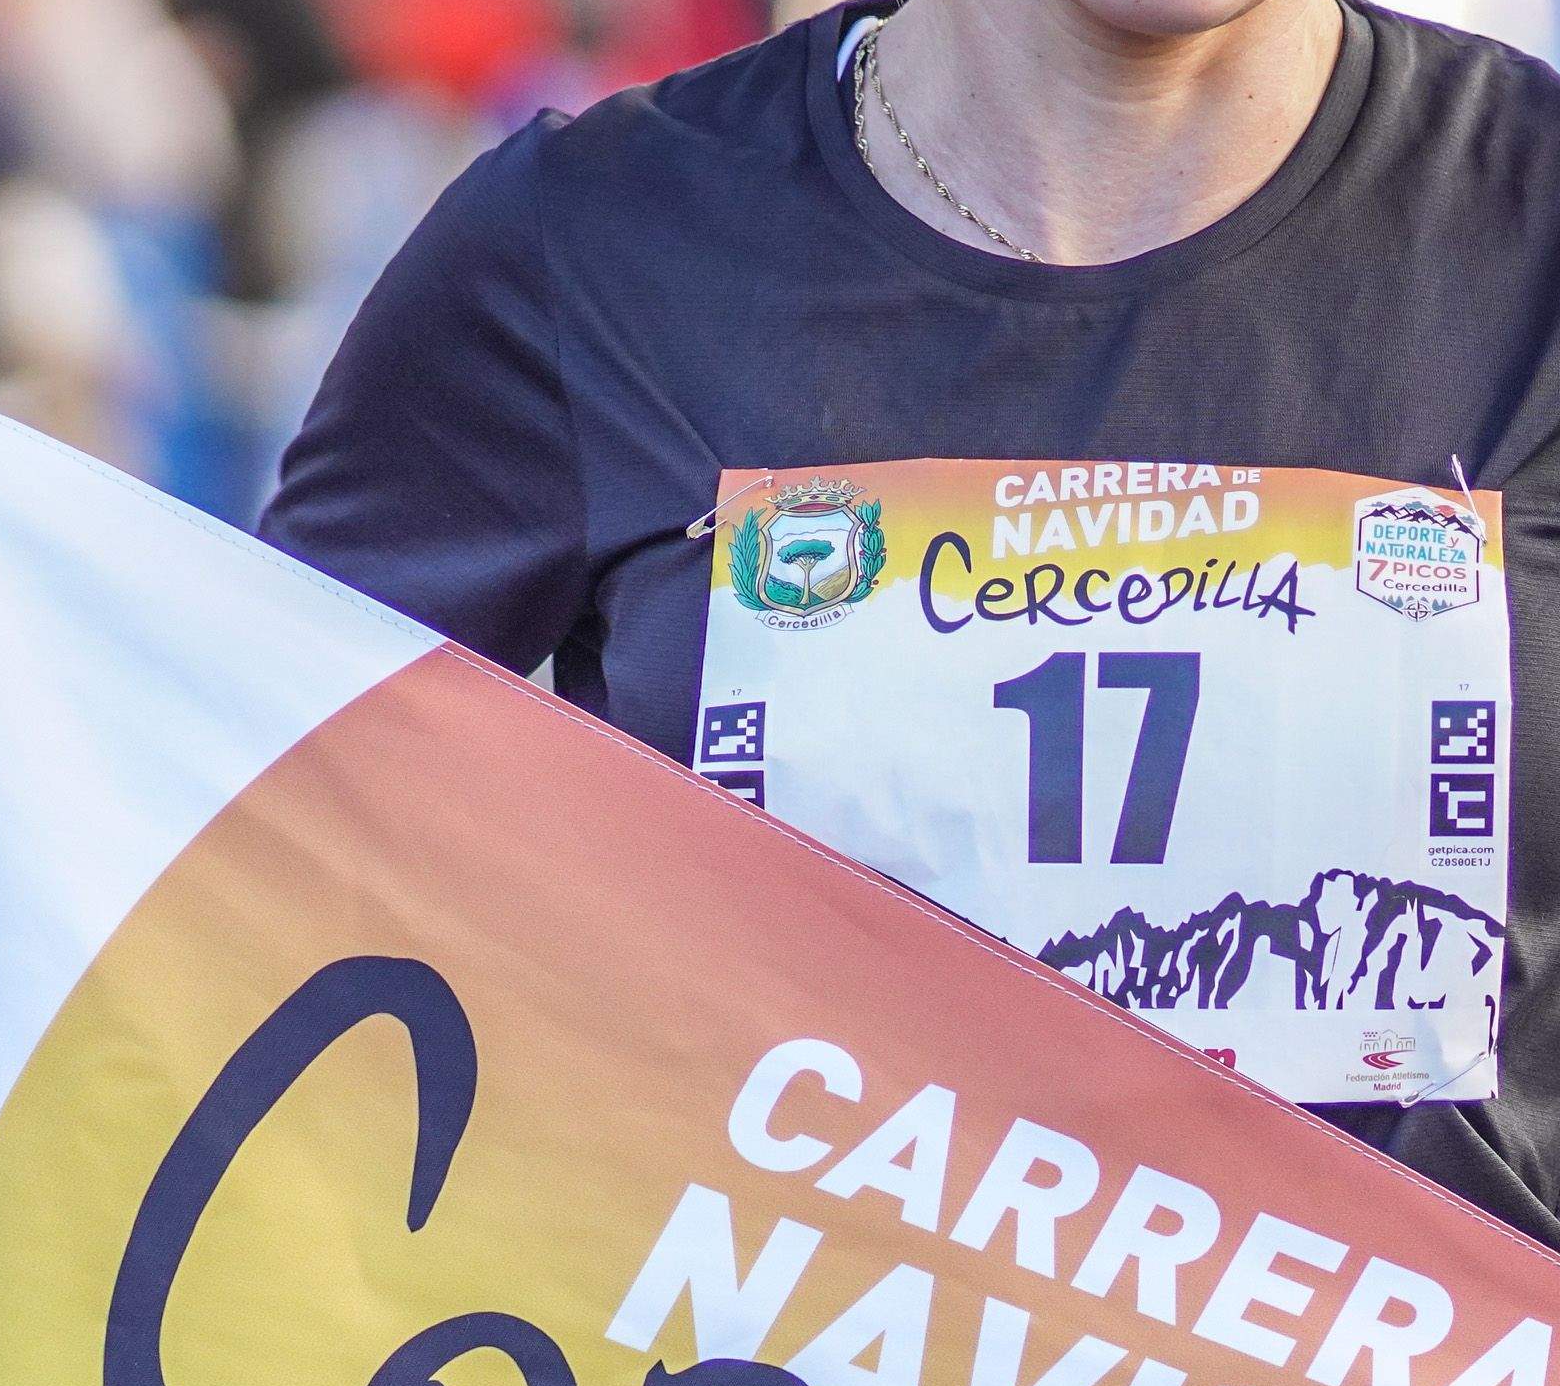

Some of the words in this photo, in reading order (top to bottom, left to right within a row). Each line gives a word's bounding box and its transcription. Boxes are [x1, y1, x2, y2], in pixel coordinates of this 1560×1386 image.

[994, 461, 1222, 508] CARRERA
[1232, 468, 1262, 485] DE
[991, 490, 1260, 560] NAVIDAD
[1373, 524, 1446, 545] DEPORTE
[1366, 542, 1467, 563] NATURALEZA
[1367, 558, 1388, 582] 7
[1392, 562, 1467, 580] PICOS
[1383, 578, 1468, 593] Cercedilla
[768, 609, 842, 629] Cercedilla
[731, 688, 742, 696] 17
[1459, 683, 1470, 691] 17
[992, 650, 1202, 865] 17
[1428, 845, 1495, 856] getpica.com
[1345, 1073, 1390, 1082] Federación
[1392, 1071, 1430, 1081] Atletismo
[1373, 1082, 1402, 1091] Madrid
